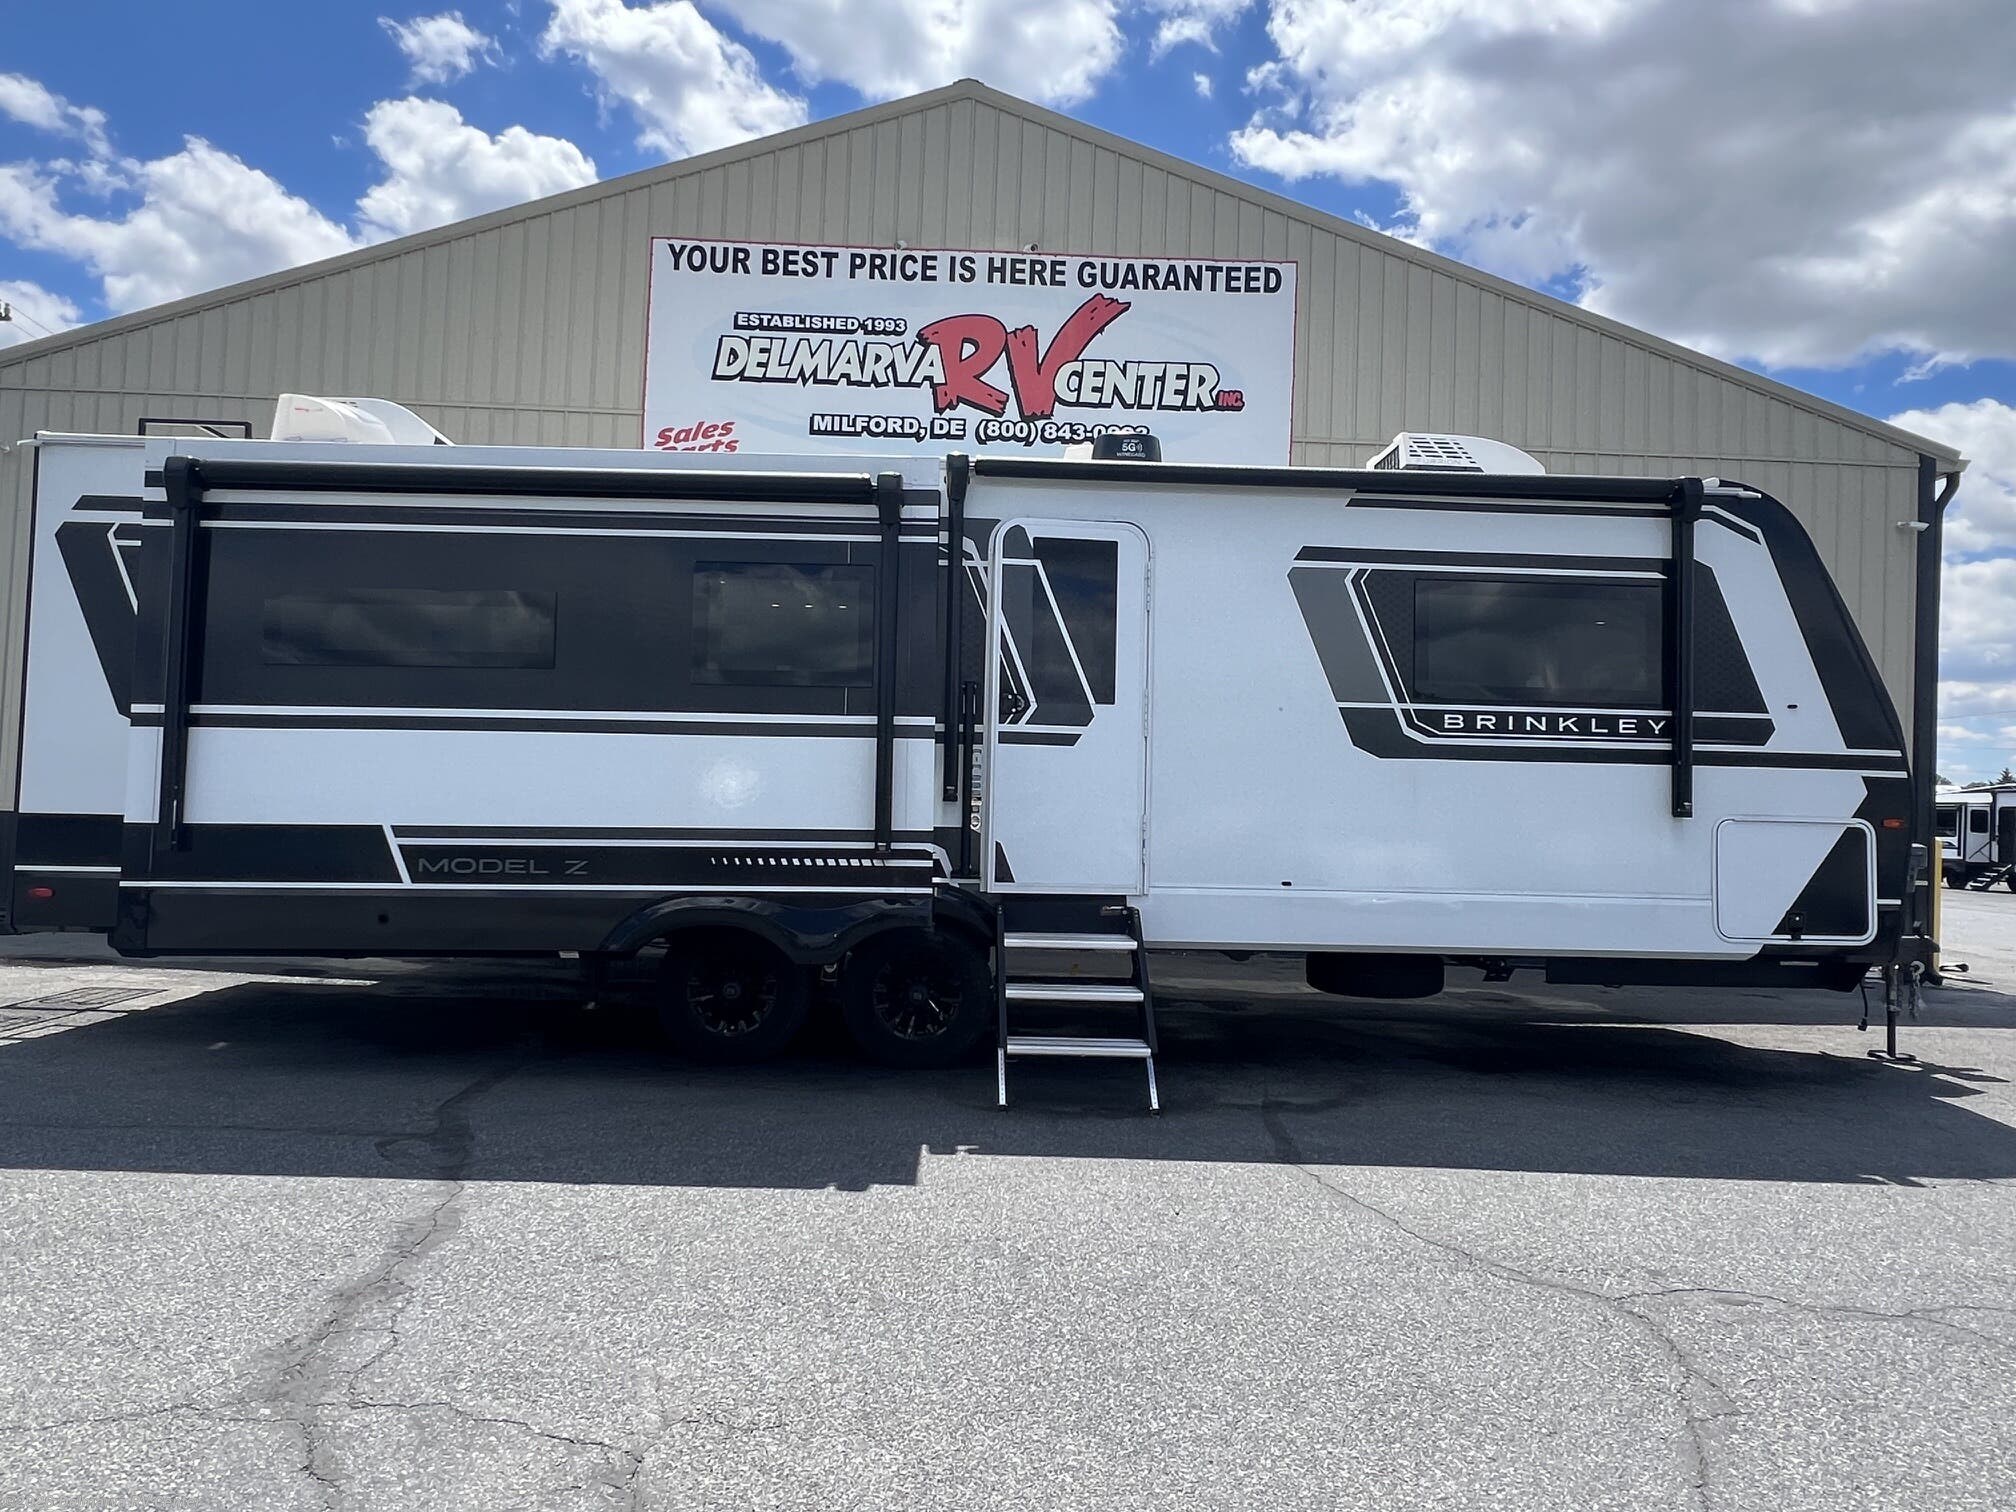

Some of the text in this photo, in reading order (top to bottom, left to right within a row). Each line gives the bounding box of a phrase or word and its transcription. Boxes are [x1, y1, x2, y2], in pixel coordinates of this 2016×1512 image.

[668, 243, 1283, 294] YOUR BEST PRICE IS HERE GUARANTEED
[736, 313, 907, 333] ESTABLISHED 1993
[713, 293, 1245, 420] DELMARVA RV CENTER INC.
[654, 420, 737, 447] Sales
[813, 414, 927, 437] MILFORD,
[933, 418, 966, 437] DE
[978, 419, 1039, 441] (800)
[1121, 442, 1137, 452] 5G
[1443, 713, 1667, 735] BRINKLEY
[418, 857, 589, 875] MODEL Z
